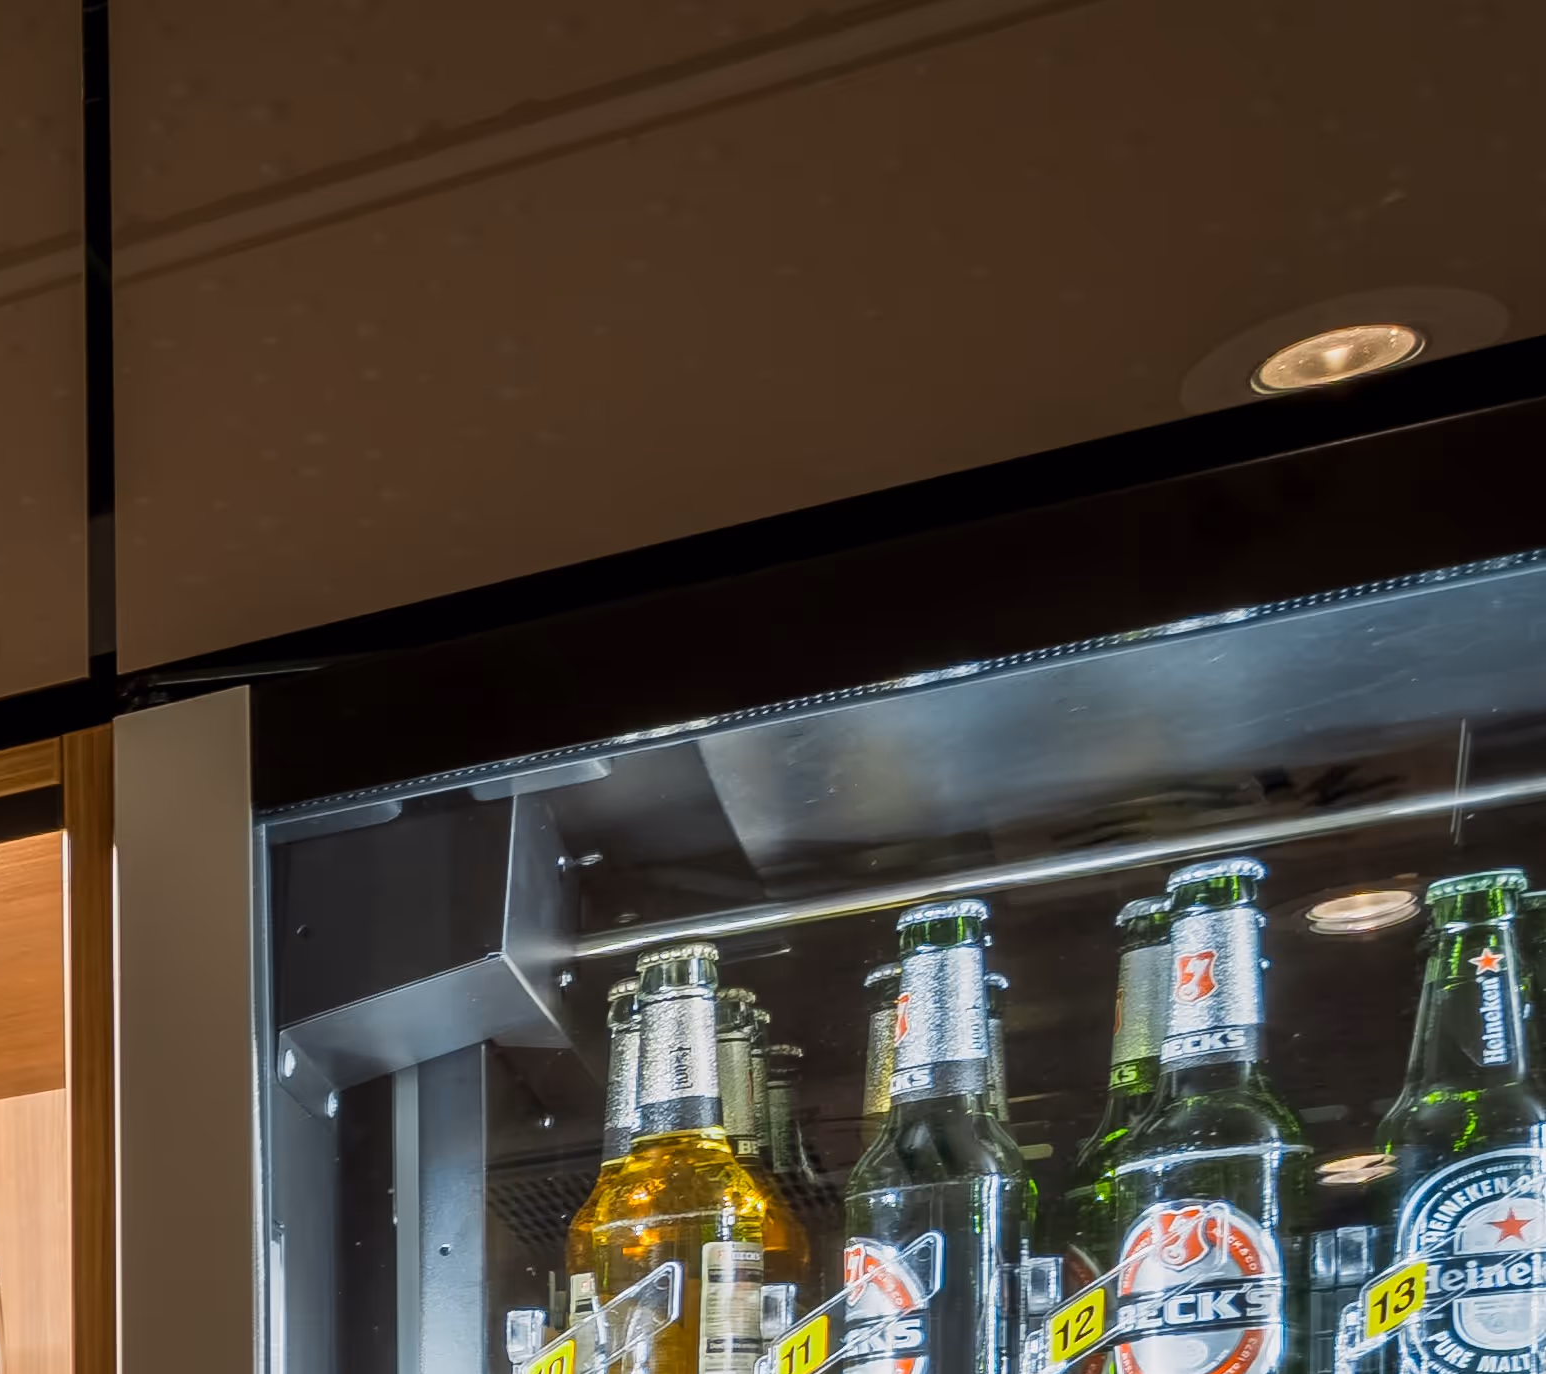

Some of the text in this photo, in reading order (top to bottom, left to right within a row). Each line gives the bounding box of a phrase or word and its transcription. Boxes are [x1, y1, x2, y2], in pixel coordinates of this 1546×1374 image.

[1482, 976, 1509, 1065] Heineken
[1118, 1283, 1281, 1330] BECK'S
[1372, 1276, 1416, 1325] 13
[1055, 1304, 1095, 1352] 12
[1427, 1330, 1531, 1373] PURE MALT
